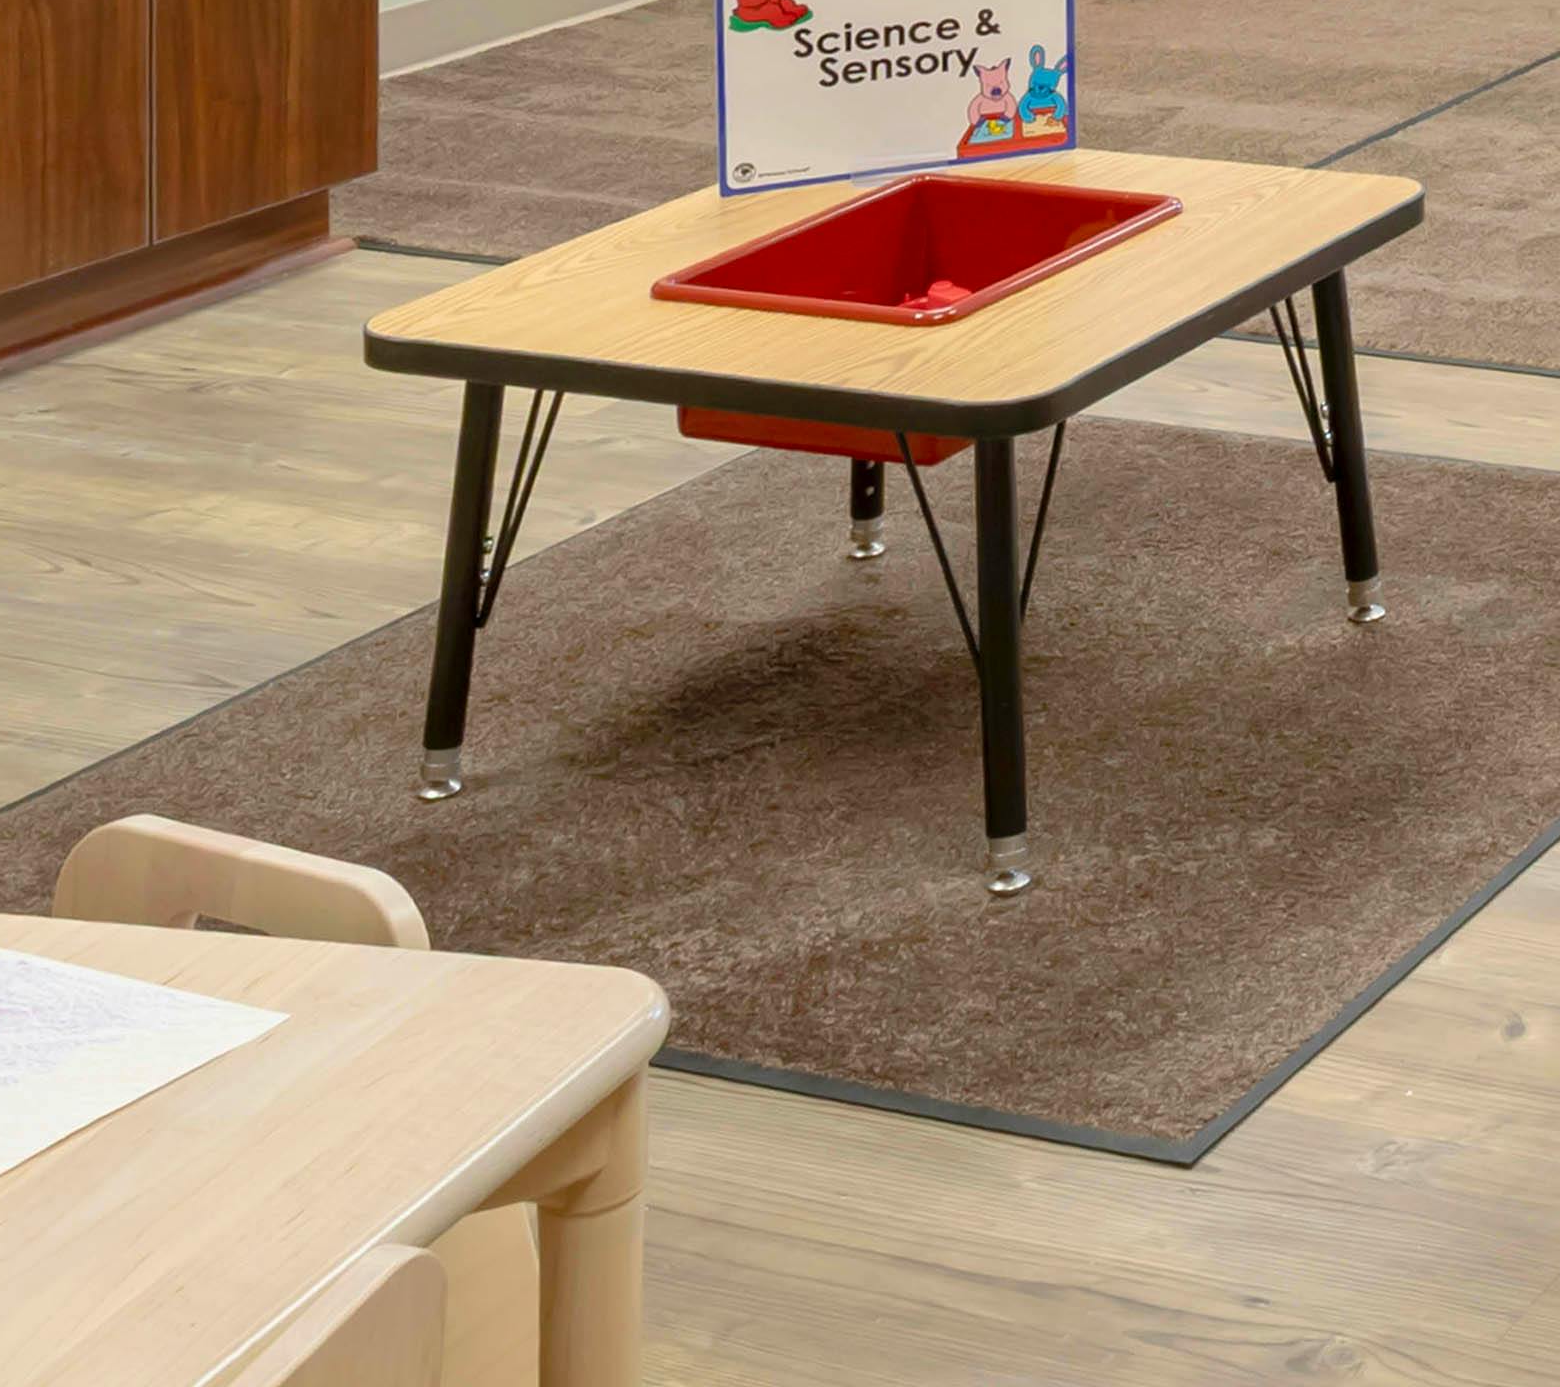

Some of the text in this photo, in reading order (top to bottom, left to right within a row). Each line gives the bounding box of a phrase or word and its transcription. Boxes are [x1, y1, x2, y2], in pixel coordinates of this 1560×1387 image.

[793, 8, 1001, 59] Science &
[818, 46, 979, 87] Sensory
